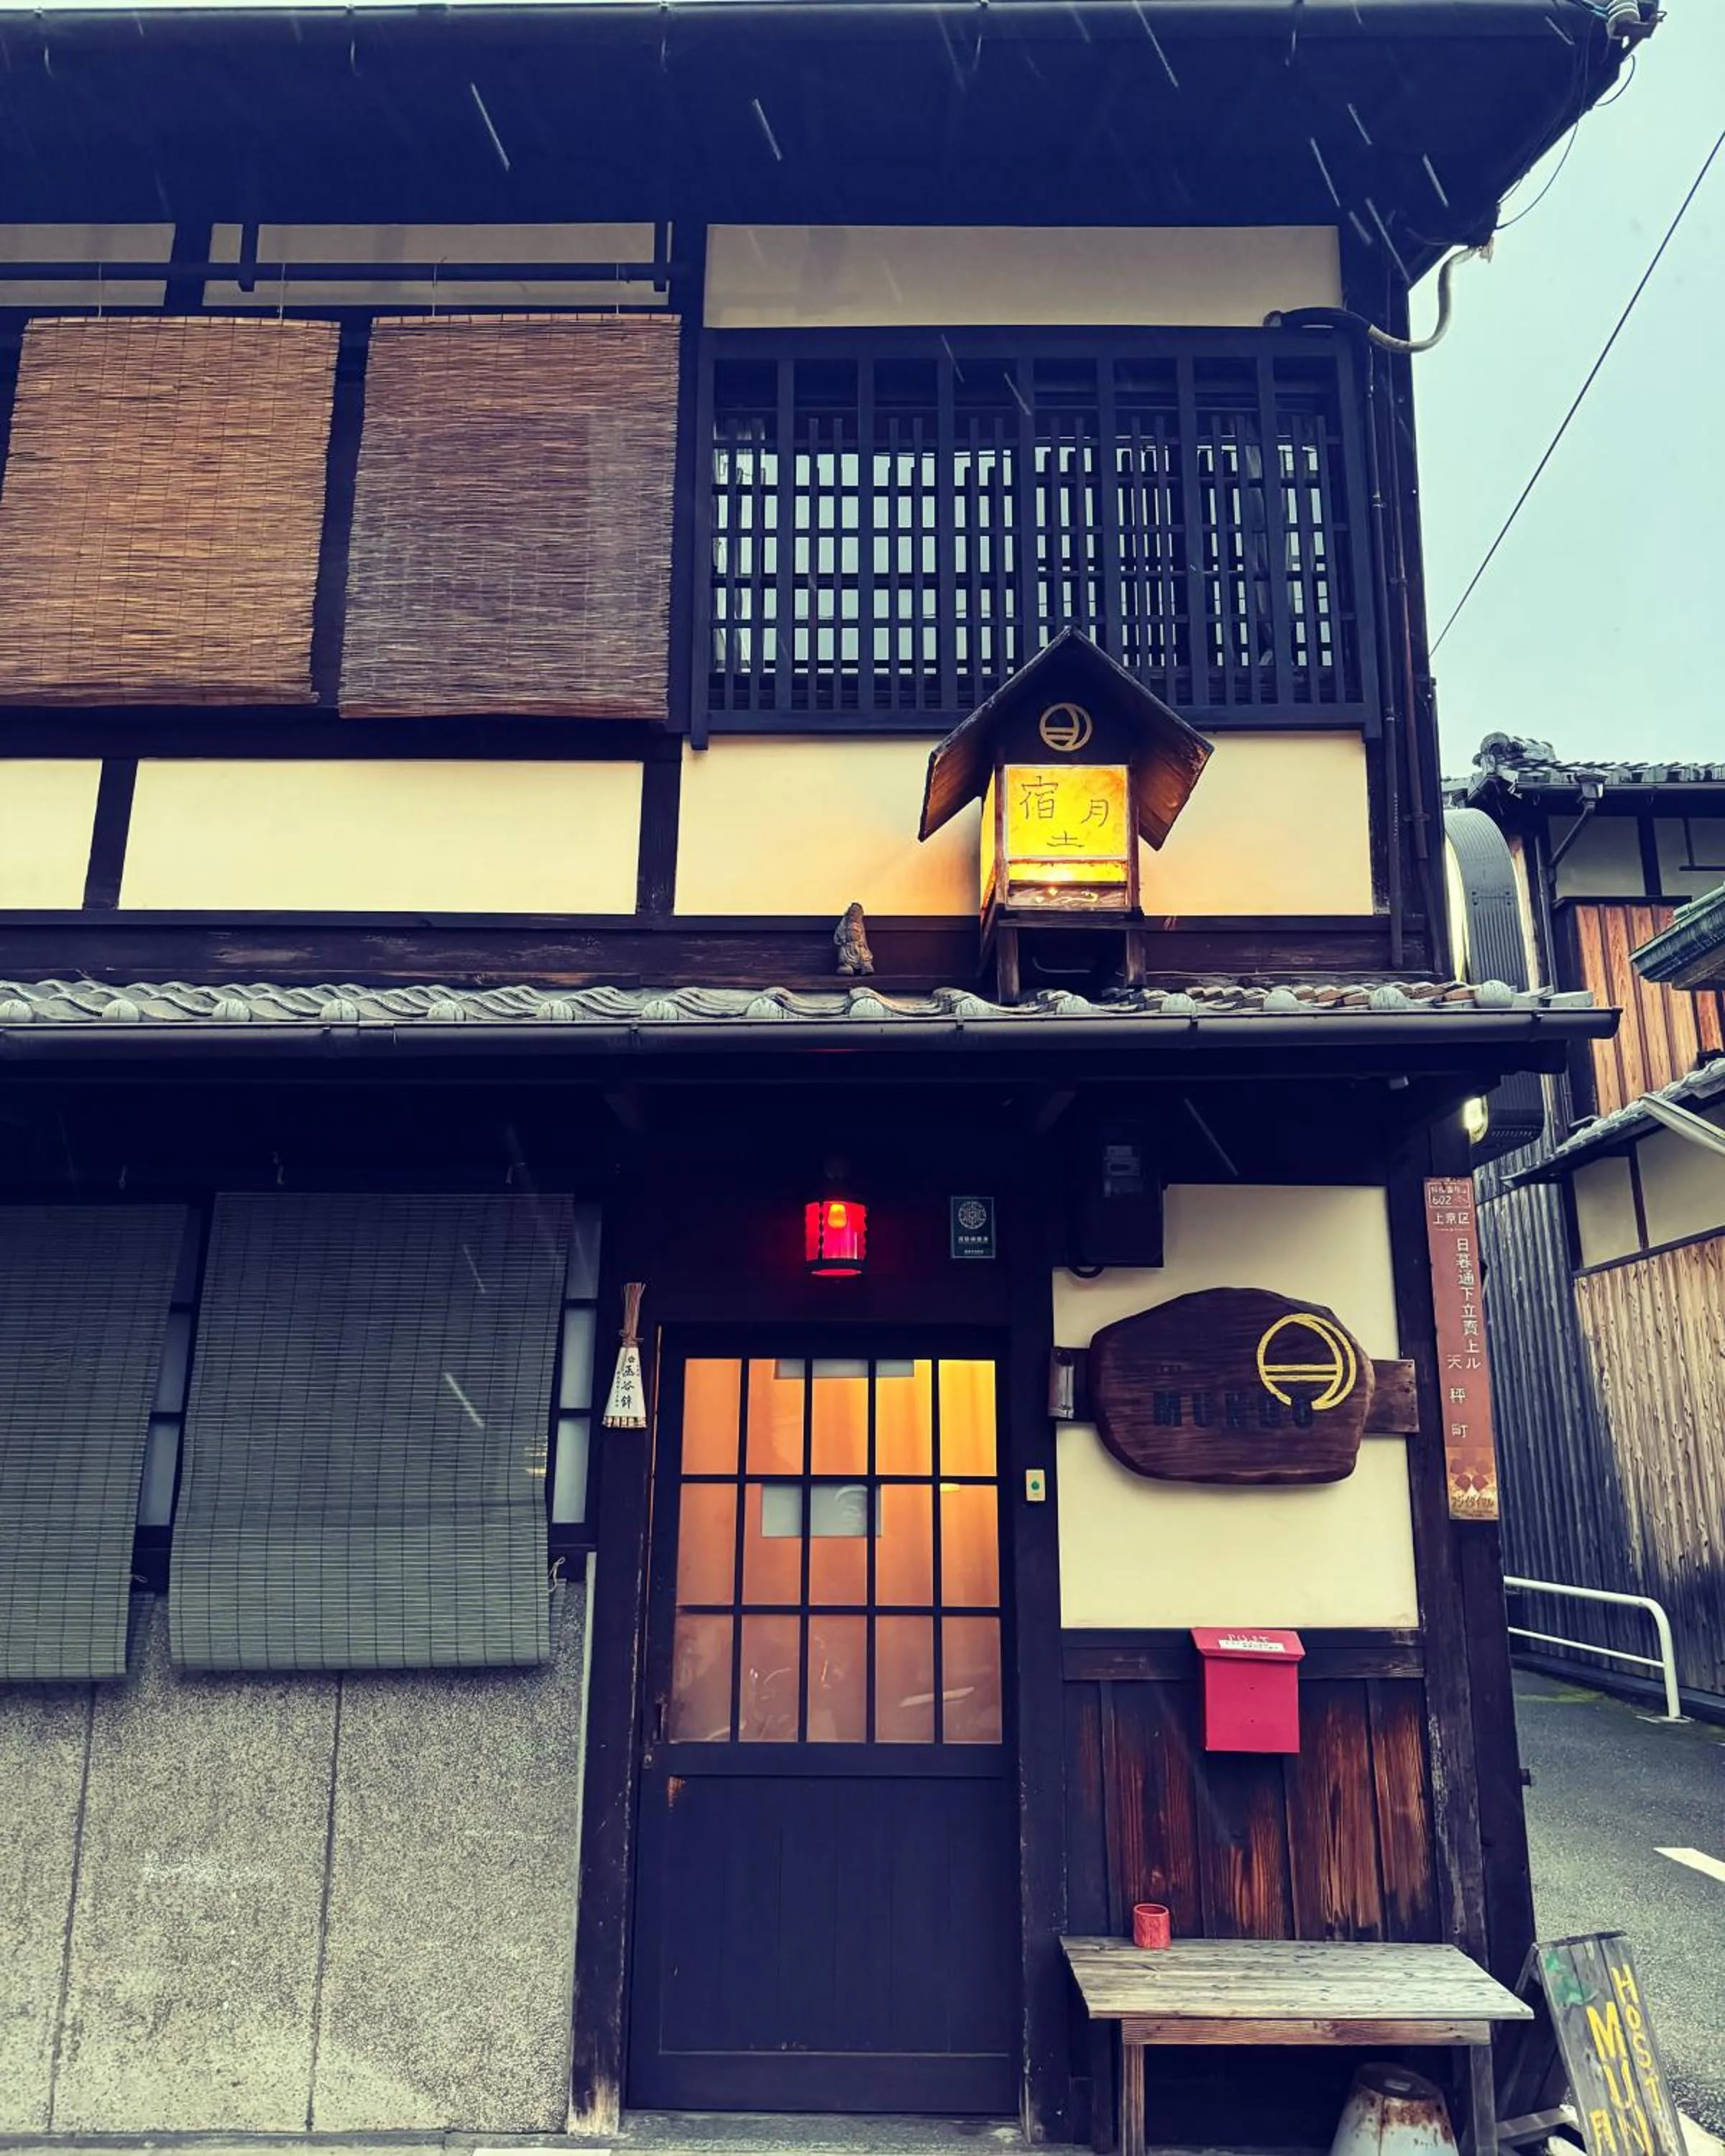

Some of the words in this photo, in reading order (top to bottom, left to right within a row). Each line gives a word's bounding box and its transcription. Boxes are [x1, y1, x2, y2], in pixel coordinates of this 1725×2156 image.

[1432, 1195, 1452, 1205] 602
[1432, 1212, 1470, 1225] 上京区
